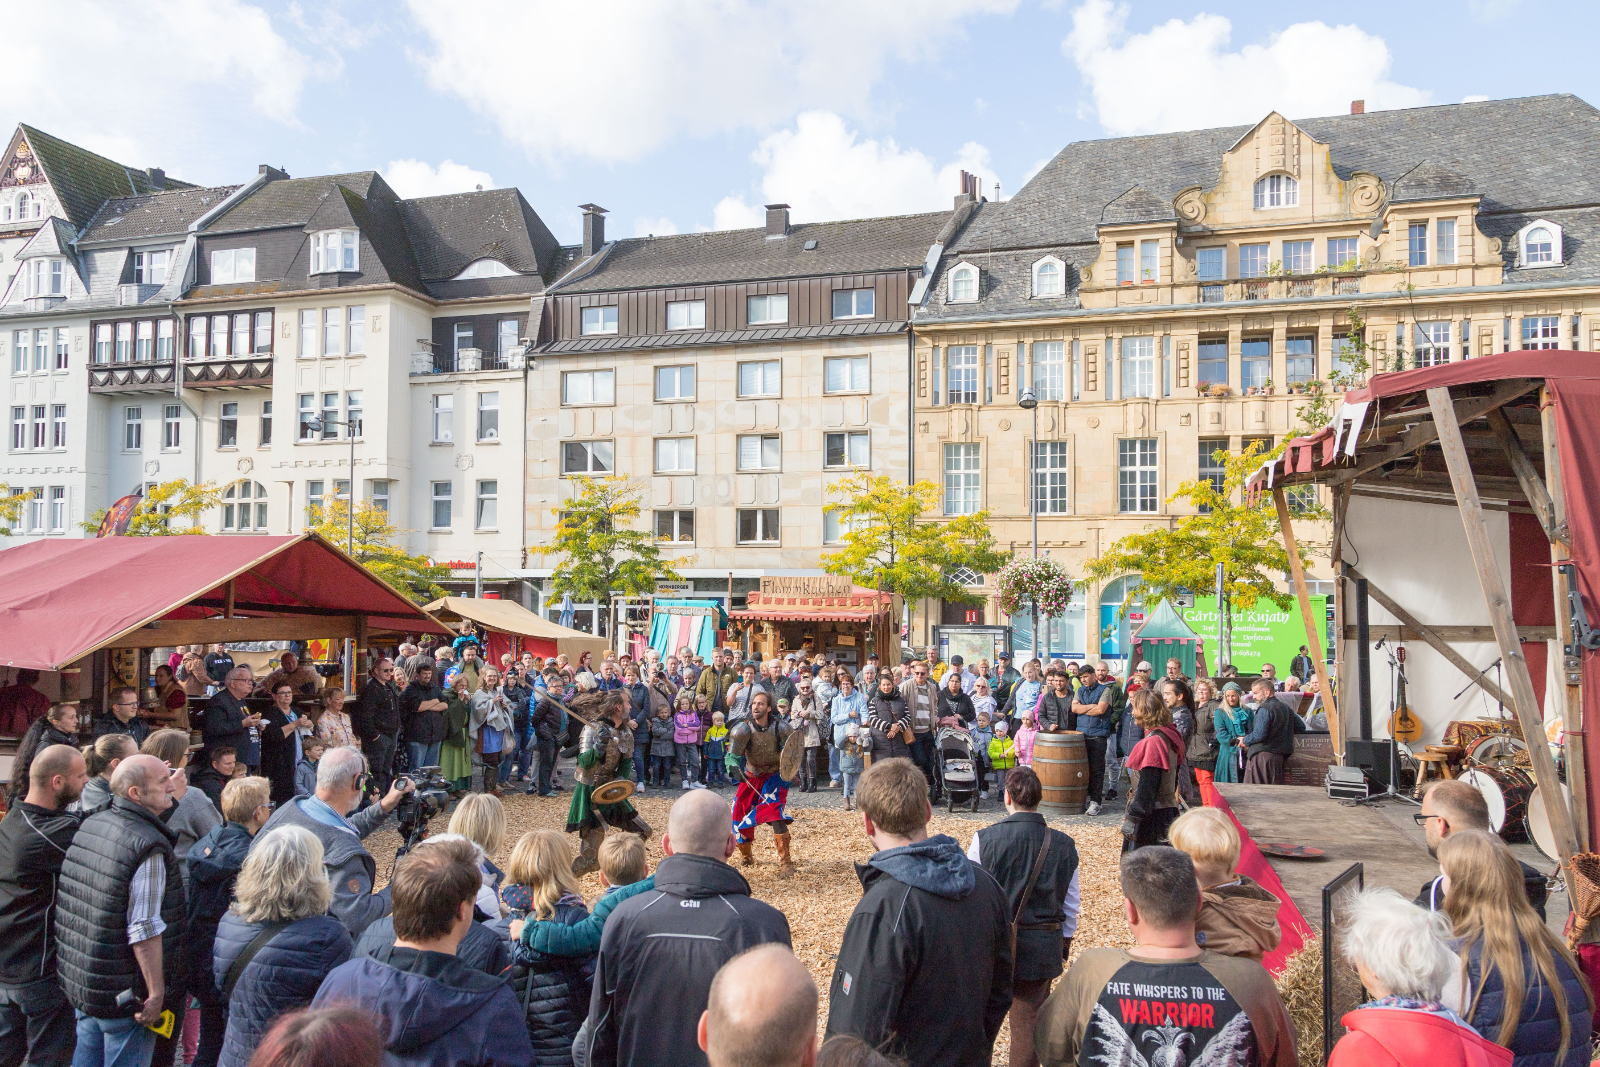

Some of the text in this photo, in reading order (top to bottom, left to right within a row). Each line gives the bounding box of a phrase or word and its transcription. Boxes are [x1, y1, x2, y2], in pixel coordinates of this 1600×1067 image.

[436, 560, 476, 569] dafone
[762, 580, 851, 595] Flammkuchen
[1247, 609, 1290, 626] Kujath
[1230, 624, 1270, 632] chnittblumen
[680, 900, 700, 908] Gill
[1107, 982, 1226, 1000] FATE WHISPERS TO THE
[1119, 998, 1215, 1028] WARRIOR
